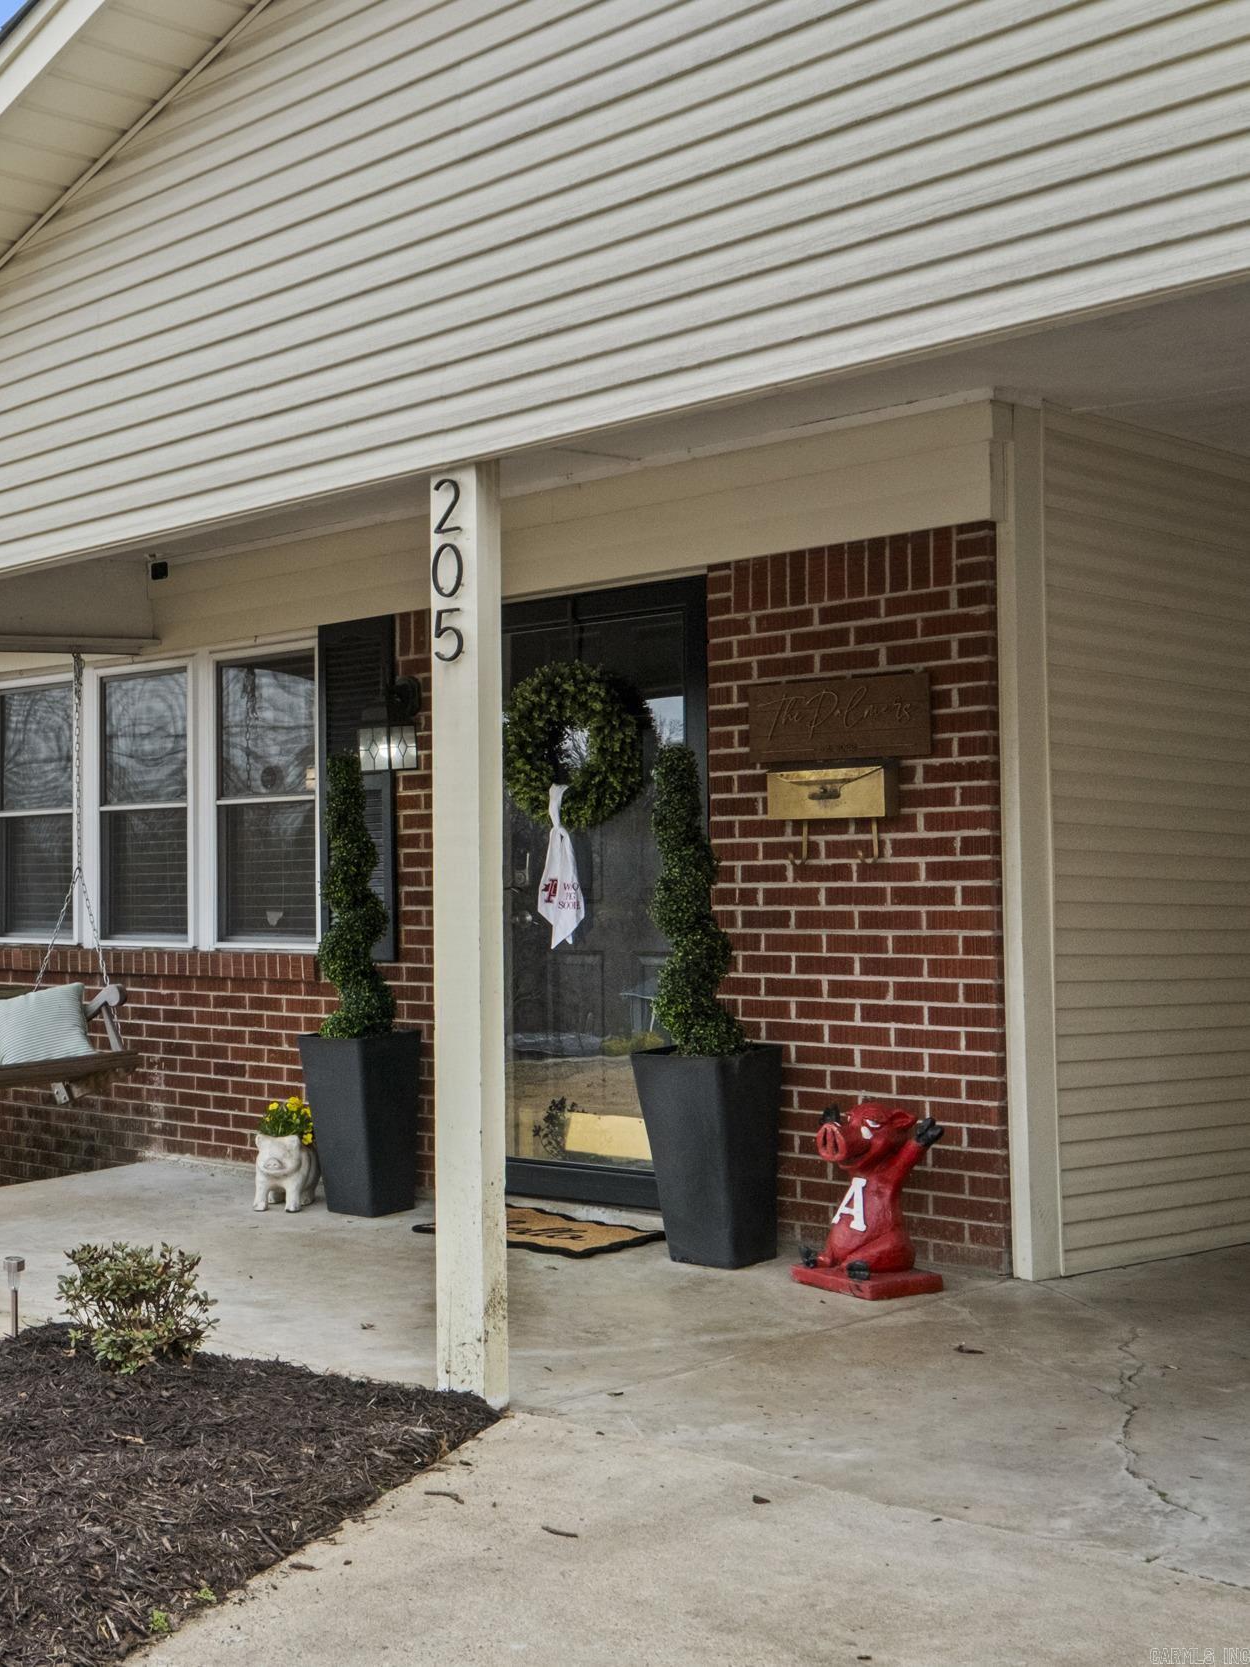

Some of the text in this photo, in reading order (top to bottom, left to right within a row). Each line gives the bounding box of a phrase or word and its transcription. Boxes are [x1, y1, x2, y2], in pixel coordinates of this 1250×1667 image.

[431, 478, 464, 662] 205
[757, 694, 804, 742] The
[831, 1177, 868, 1232] A
